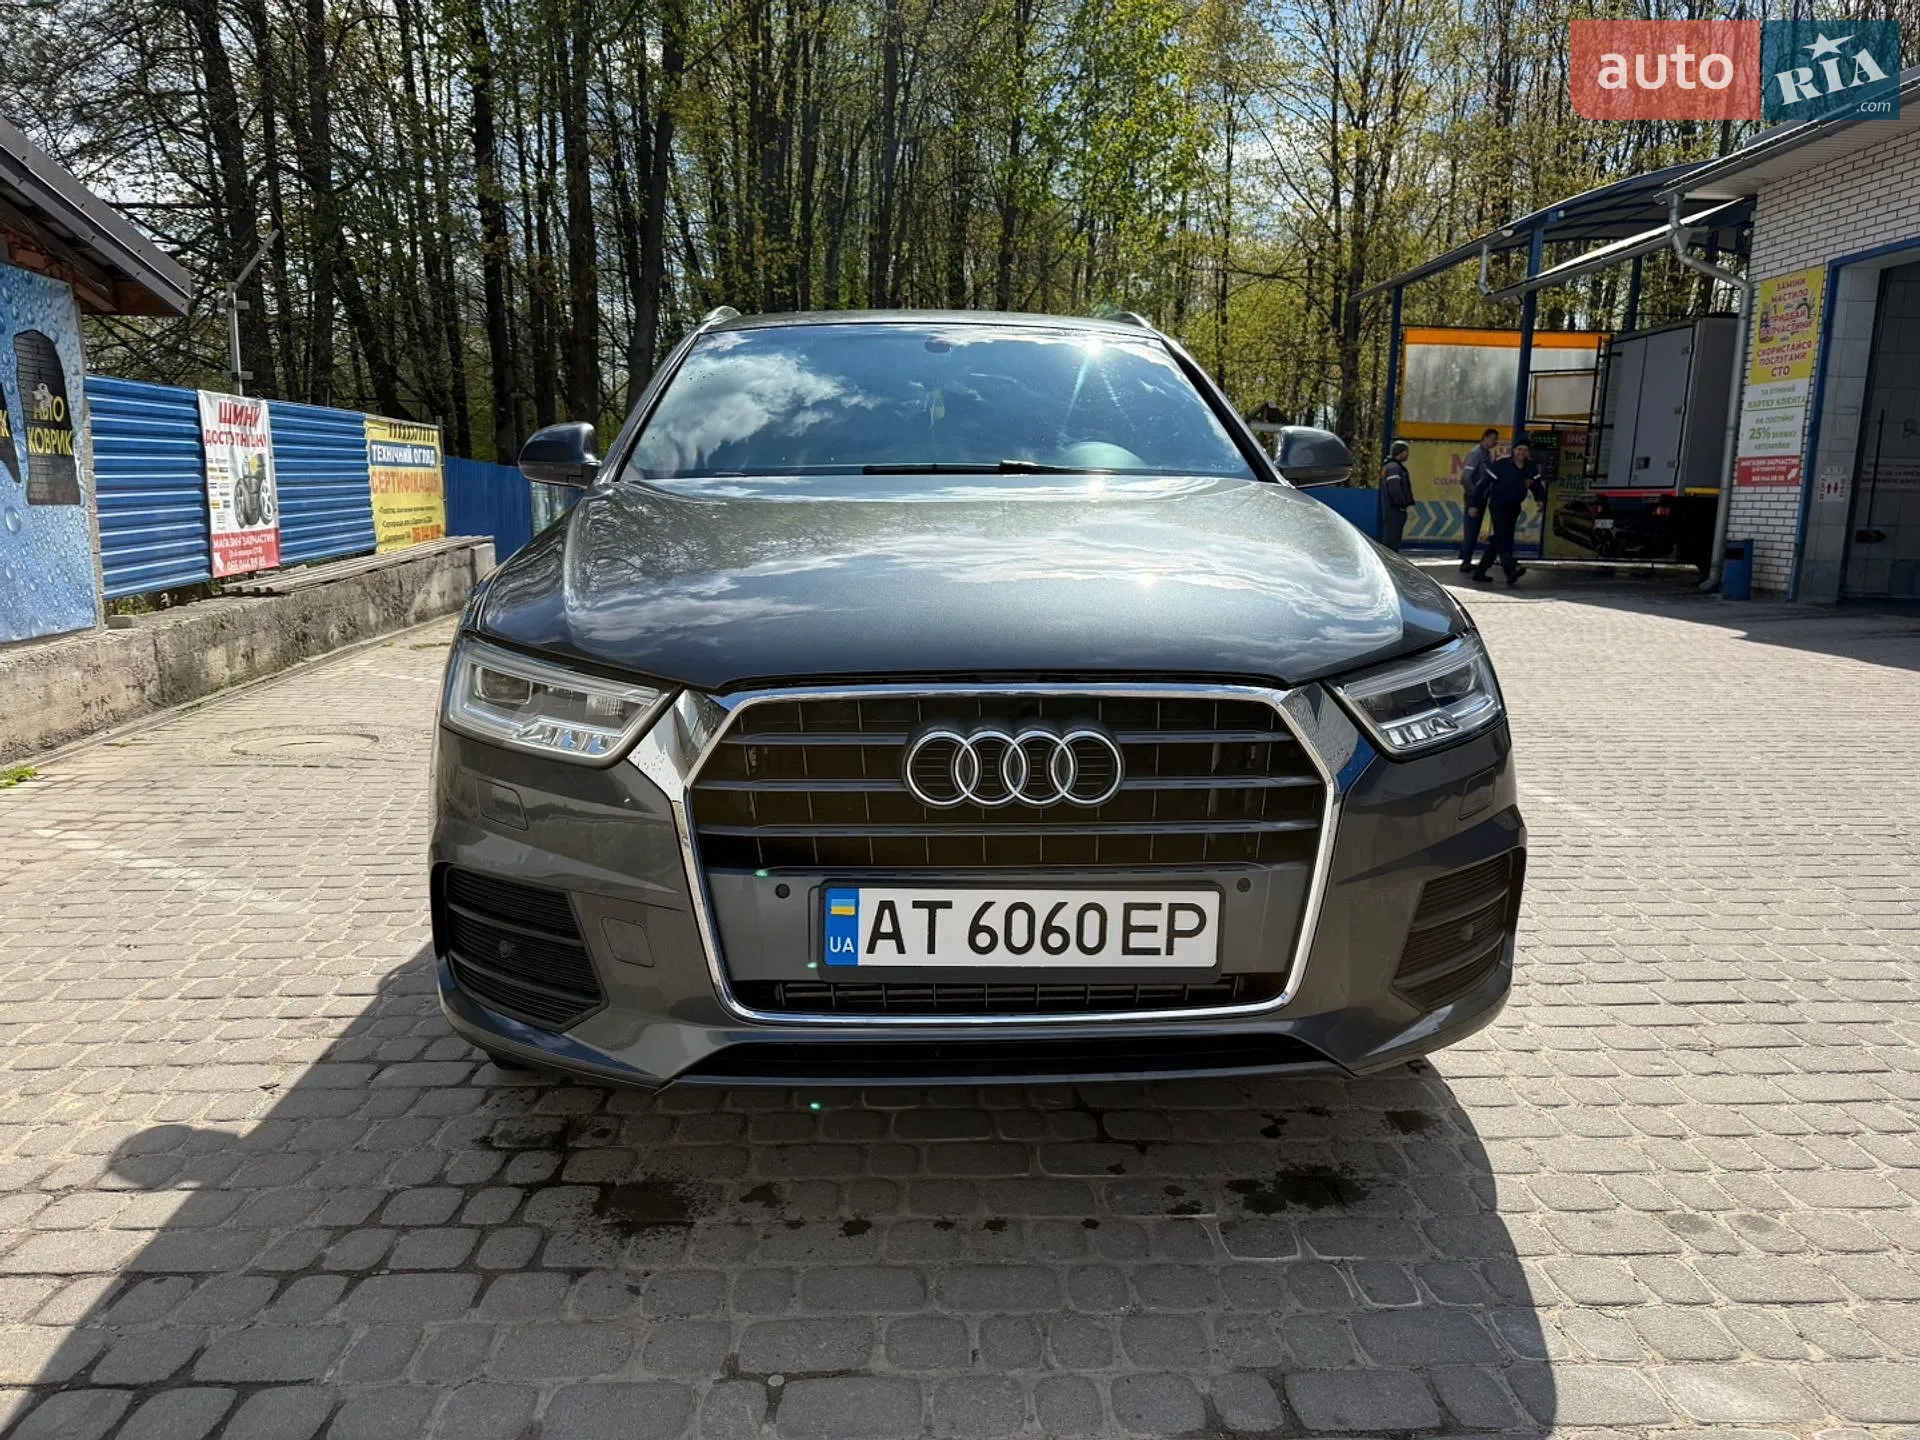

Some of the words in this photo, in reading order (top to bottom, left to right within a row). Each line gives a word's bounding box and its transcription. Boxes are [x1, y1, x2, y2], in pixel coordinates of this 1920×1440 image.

[1771, 287, 1809, 303] МАСТИЛО
[1770, 365, 1791, 378] СТО
[27, 426, 73, 455] КОВРИК
[1748, 427, 1771, 441] 25%
[967, 901, 1108, 956] 6060
[829, 938, 855, 954] UA
